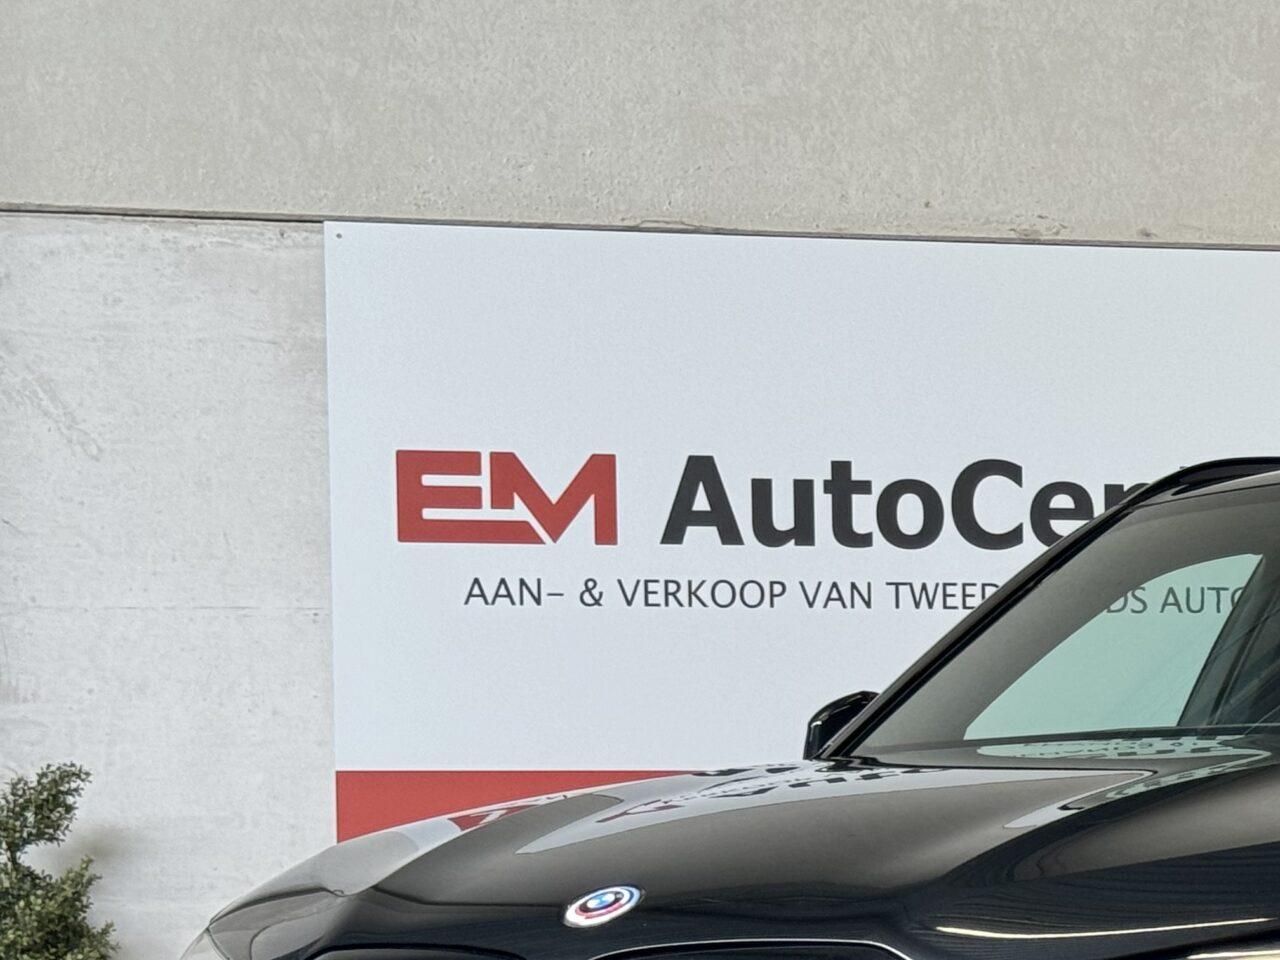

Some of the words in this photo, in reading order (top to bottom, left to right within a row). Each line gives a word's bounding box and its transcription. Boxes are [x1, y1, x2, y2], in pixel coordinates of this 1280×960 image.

[396, 450, 618, 545] EM
[659, 453, 1150, 550] AutoCe
[464, 577, 564, 606] AAN-
[579, 577, 604, 607] &
[616, 578, 788, 609] VERKOOP
[799, 580, 873, 609] VAN
